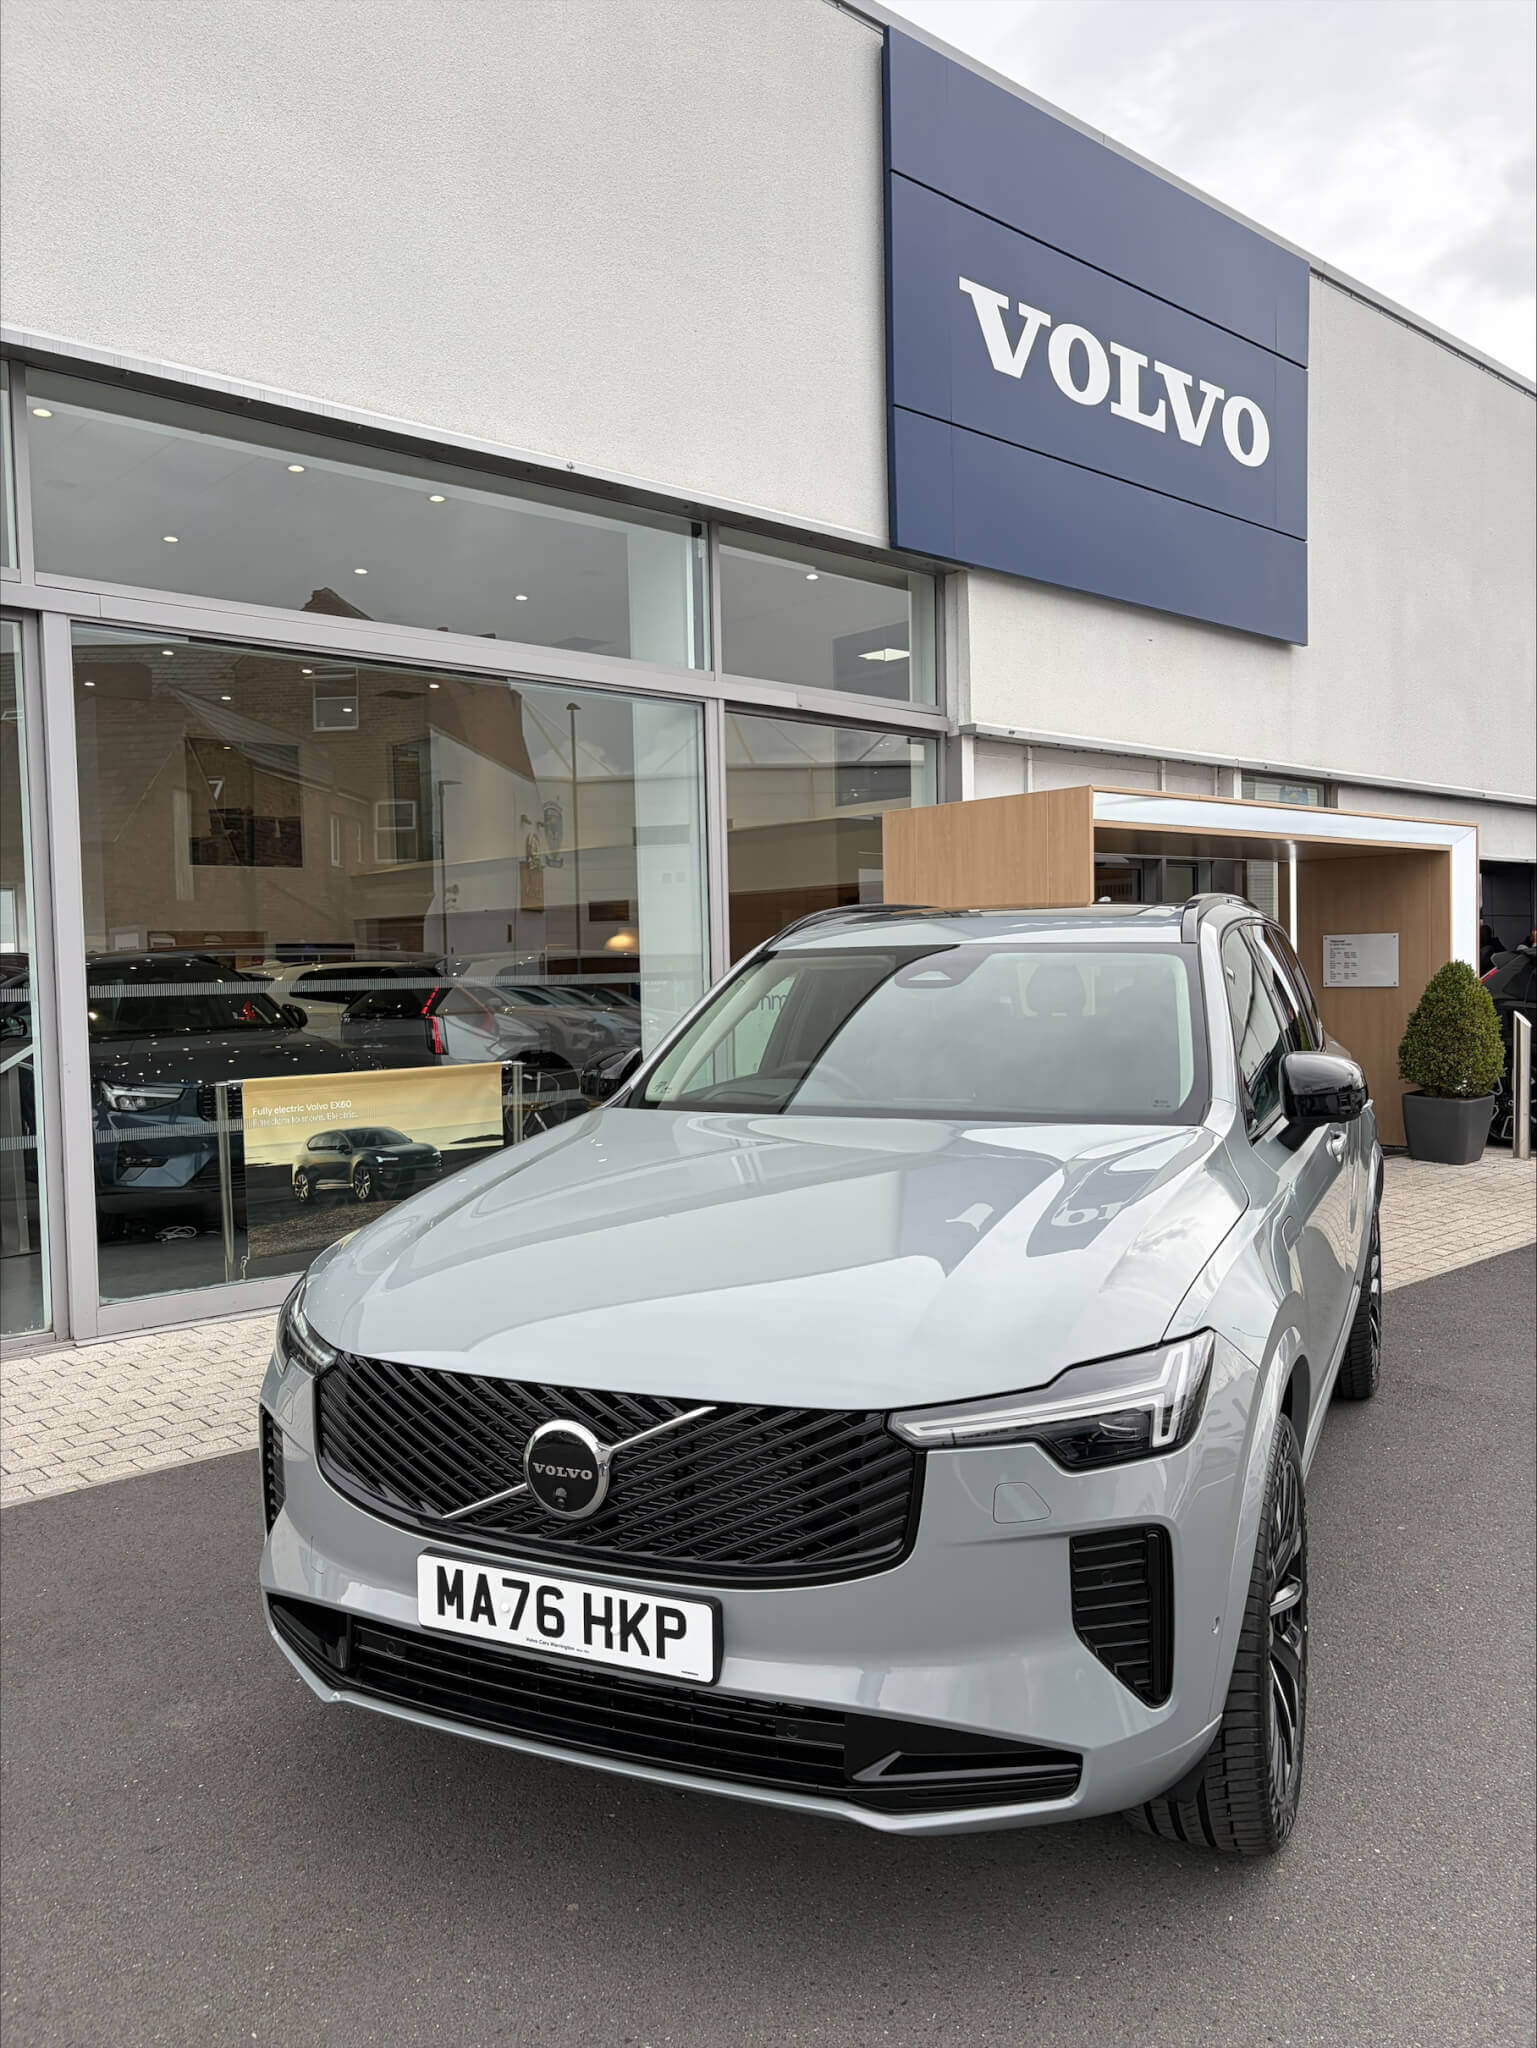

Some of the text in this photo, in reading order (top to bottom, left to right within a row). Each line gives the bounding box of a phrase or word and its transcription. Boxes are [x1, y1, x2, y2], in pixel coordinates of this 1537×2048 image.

[959, 276, 1270, 467] VOLVO
[252, 1100, 352, 1117] Fully electric Volvo EX60
[532, 1462, 593, 1480] VOLVO
[436, 1565, 687, 1660] MA76 HKP
